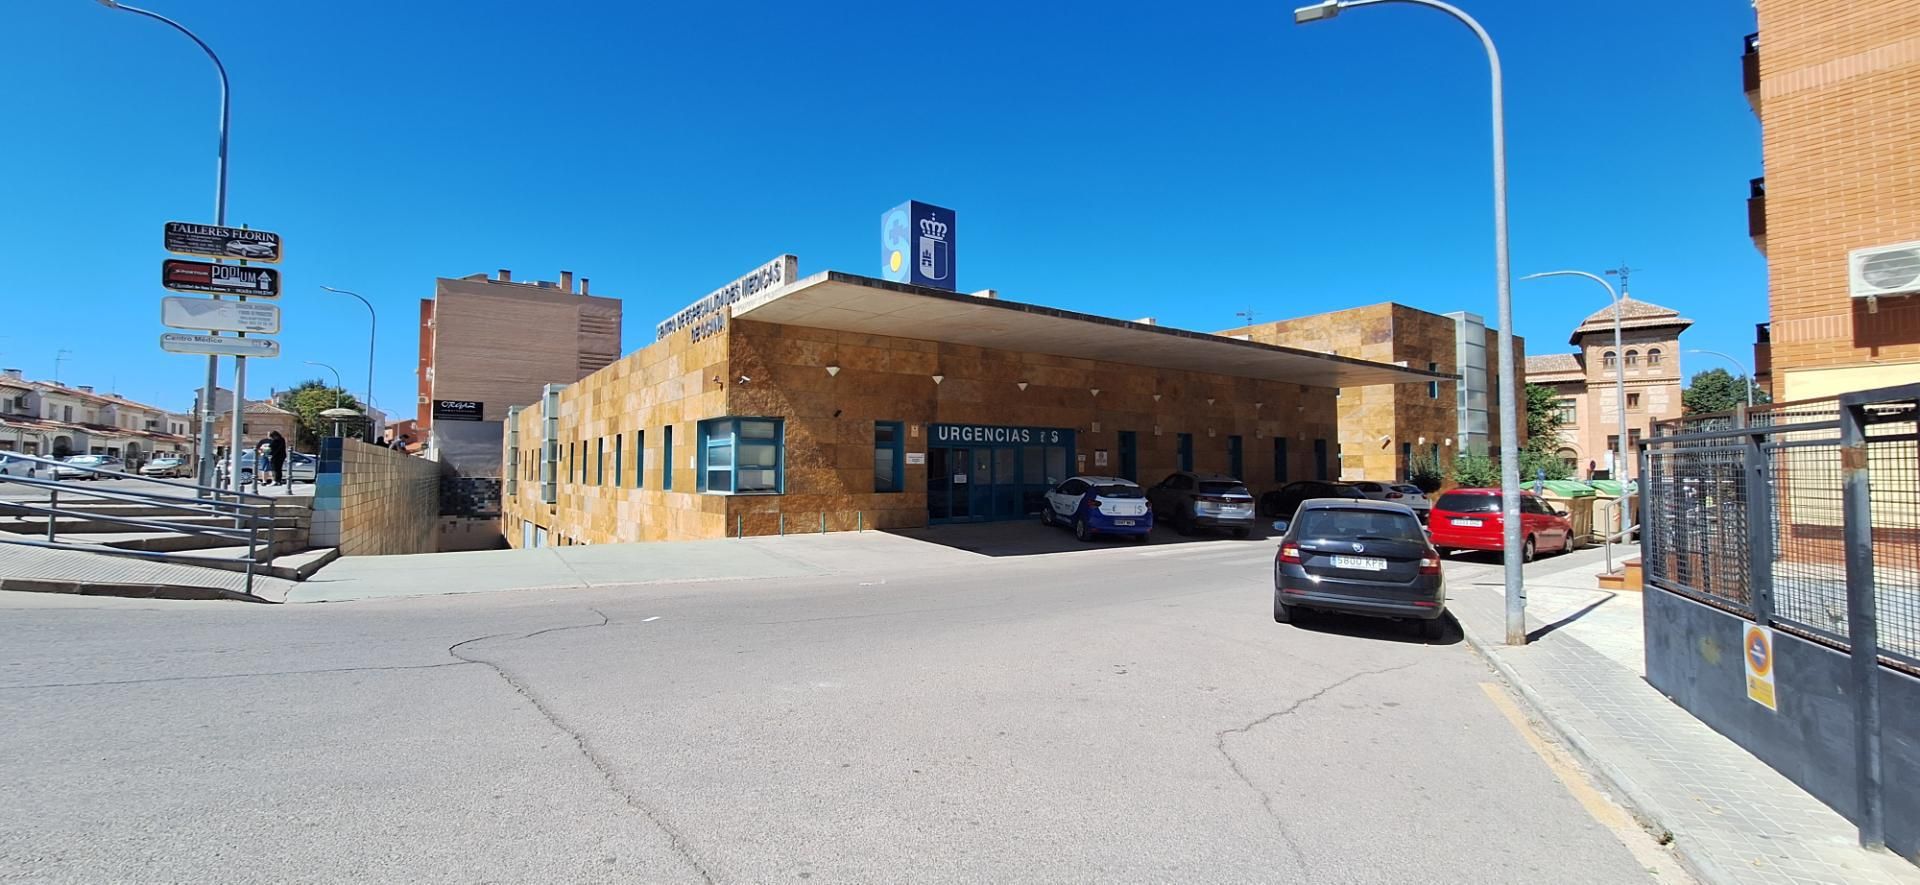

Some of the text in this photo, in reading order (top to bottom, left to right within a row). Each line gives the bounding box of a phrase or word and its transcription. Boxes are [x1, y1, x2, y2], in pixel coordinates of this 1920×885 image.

[170, 223, 229, 238] TALLERES
[232, 229, 275, 242] FLORIN
[211, 265, 257, 282] PODIUM
[164, 334, 193, 342] Centro
[938, 425, 1030, 443] URGENCIAS
